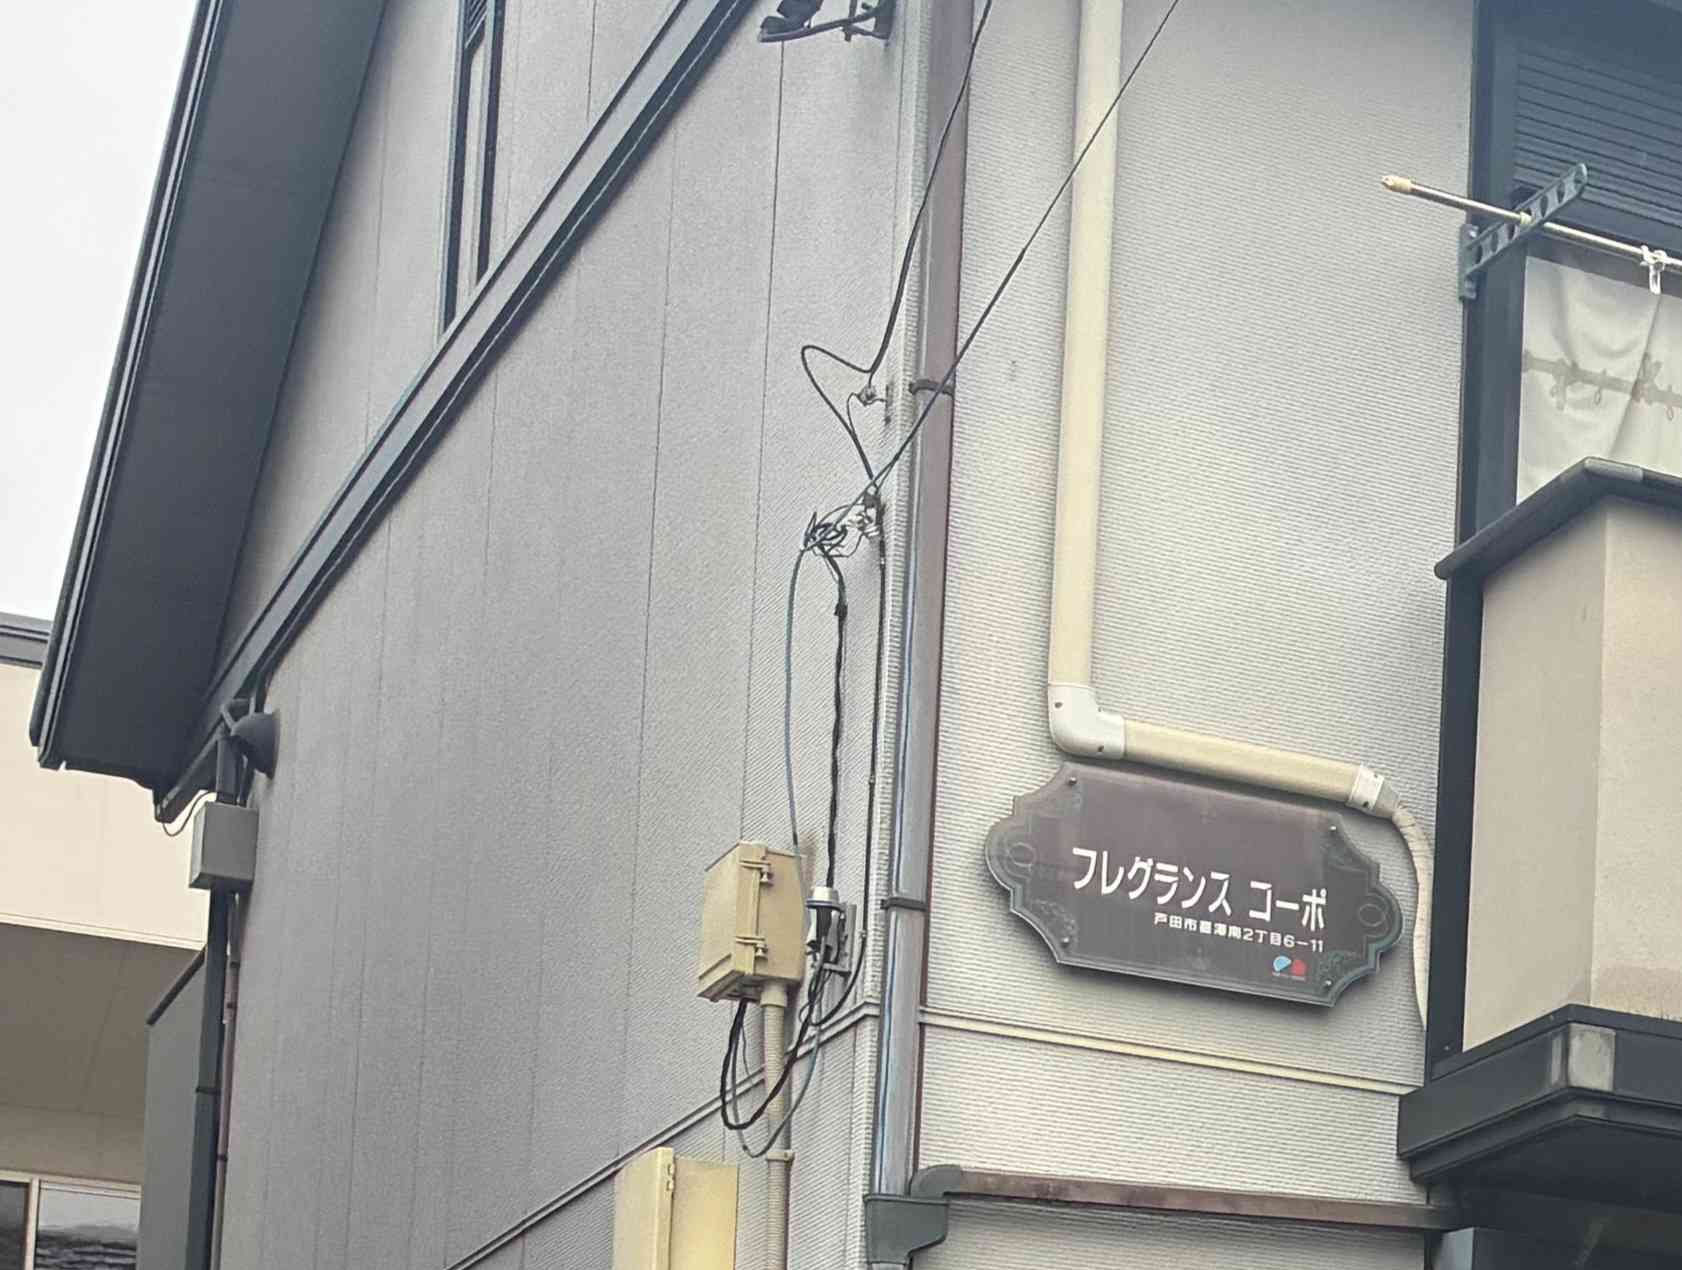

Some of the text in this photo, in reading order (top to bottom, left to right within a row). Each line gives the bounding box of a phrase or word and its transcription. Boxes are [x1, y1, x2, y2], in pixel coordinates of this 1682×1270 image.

[1072, 847, 1327, 930] フレグランス コーポ
